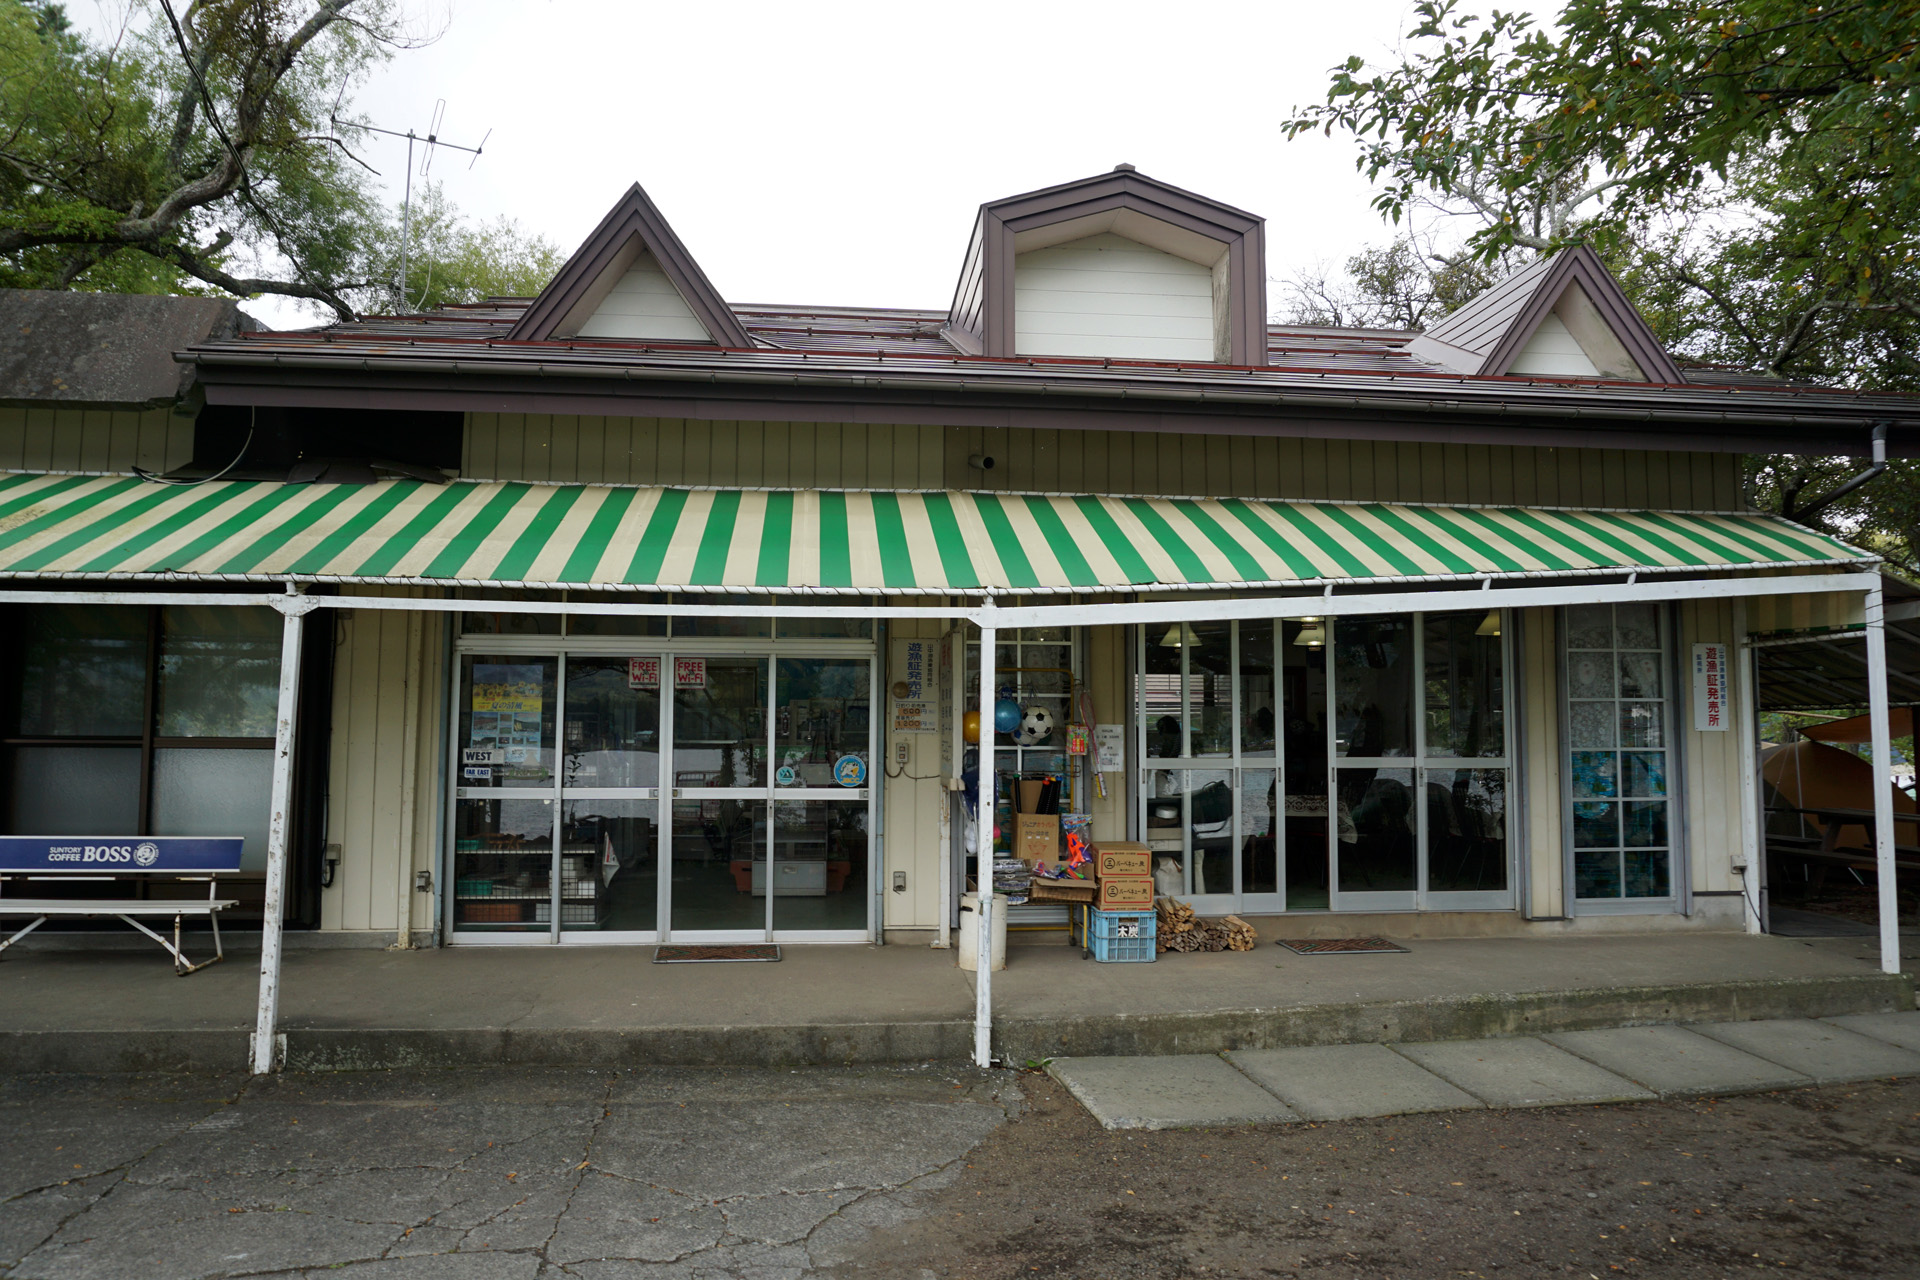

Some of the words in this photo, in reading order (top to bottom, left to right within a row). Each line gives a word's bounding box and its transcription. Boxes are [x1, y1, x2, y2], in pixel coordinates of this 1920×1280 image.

[631, 661, 657, 671] FREE
[677, 661, 703, 672] FREE
[906, 642, 922, 699] 遊漁証発売所
[631, 672, 657, 682] Wi-Fi
[677, 672, 703, 682] Wi-Fi
[1705, 647, 1720, 727] 遊漁証発売所
[465, 751, 492, 761] WEST
[82, 846, 131, 862] BOSS
[1118, 924, 1138, 937] 木炭
